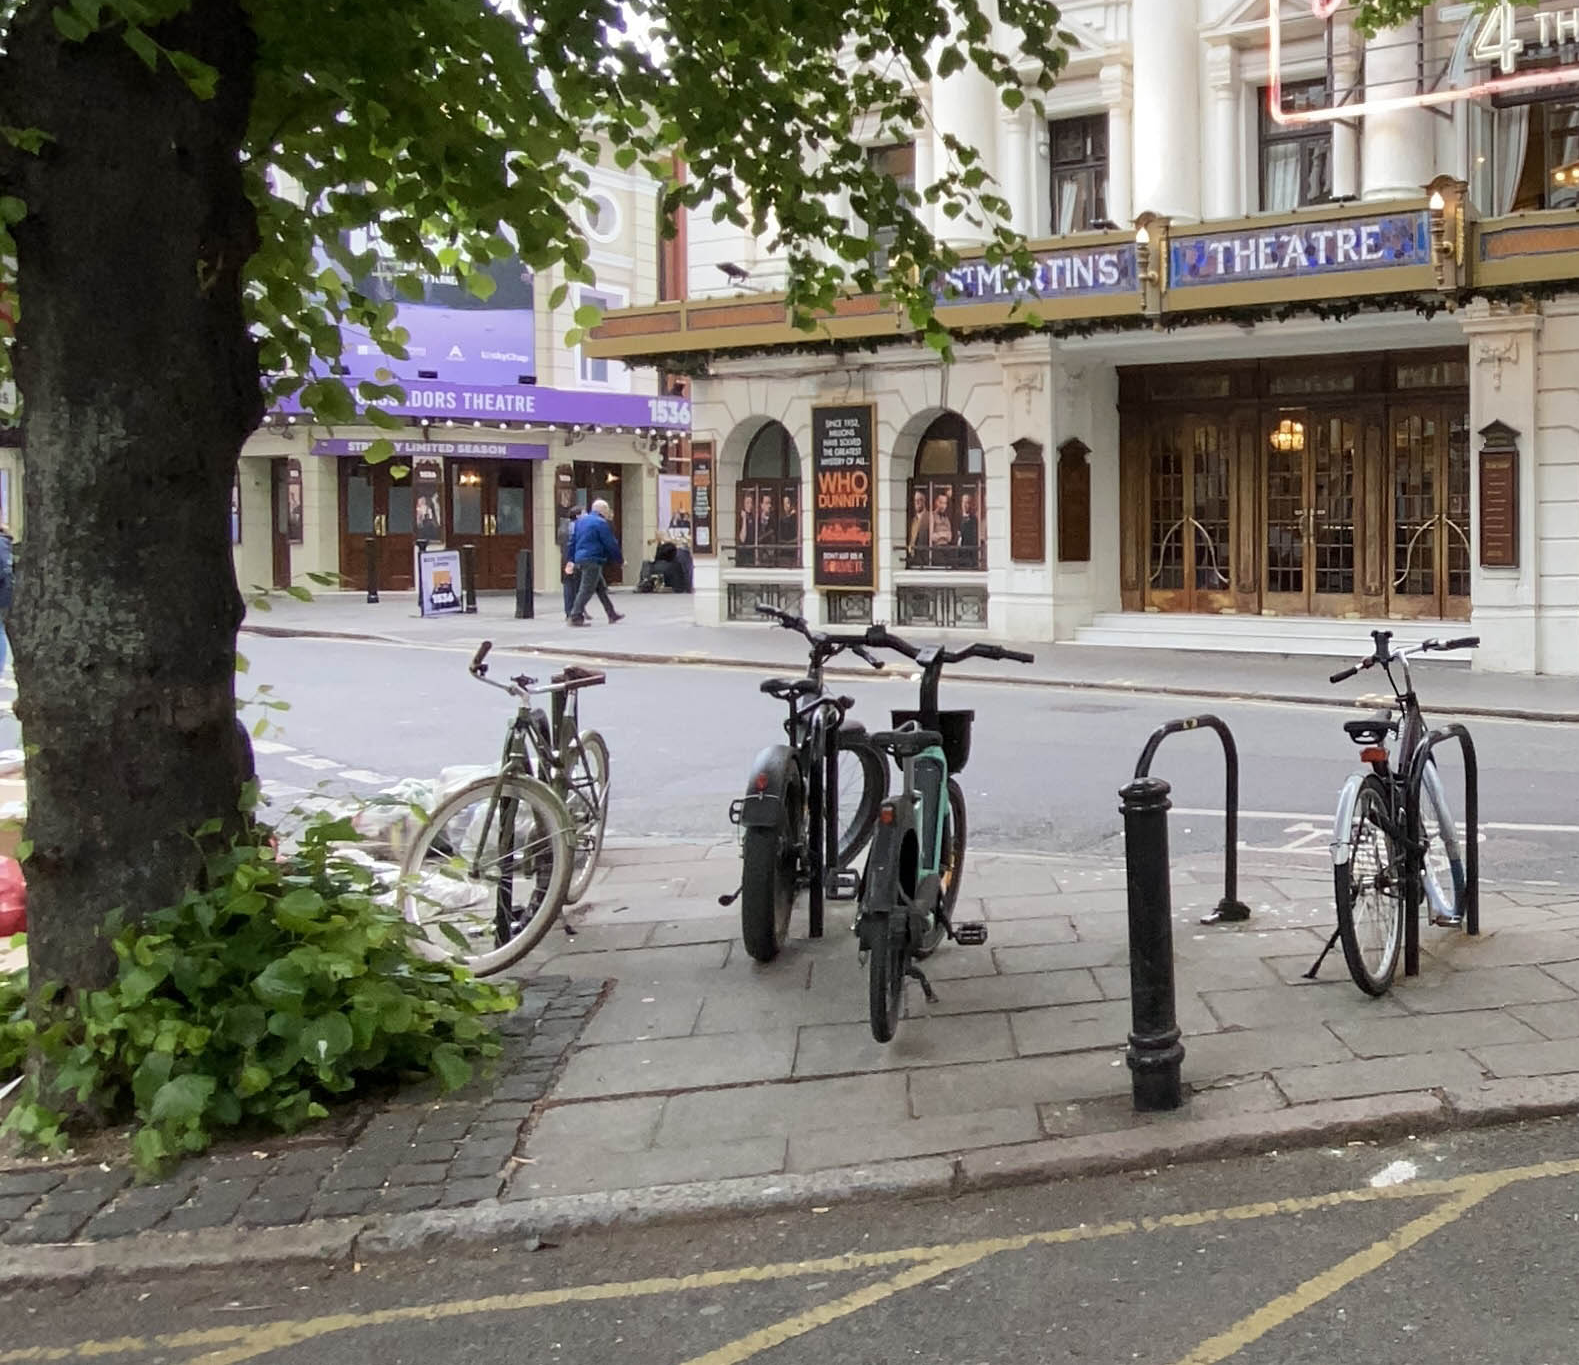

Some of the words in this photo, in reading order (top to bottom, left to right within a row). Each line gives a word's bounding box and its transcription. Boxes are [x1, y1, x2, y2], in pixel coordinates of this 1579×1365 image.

[1208, 223, 1386, 276] THEATRE
[462, 392, 536, 413] THEATRE
[647, 398, 691, 425] 1536
[347, 441, 404, 453] STRY
[405, 442, 455, 454] LIMITED
[457, 444, 507, 455] SEASON
[818, 470, 869, 494] WHO
[818, 494, 869, 509] DUNNIT?
